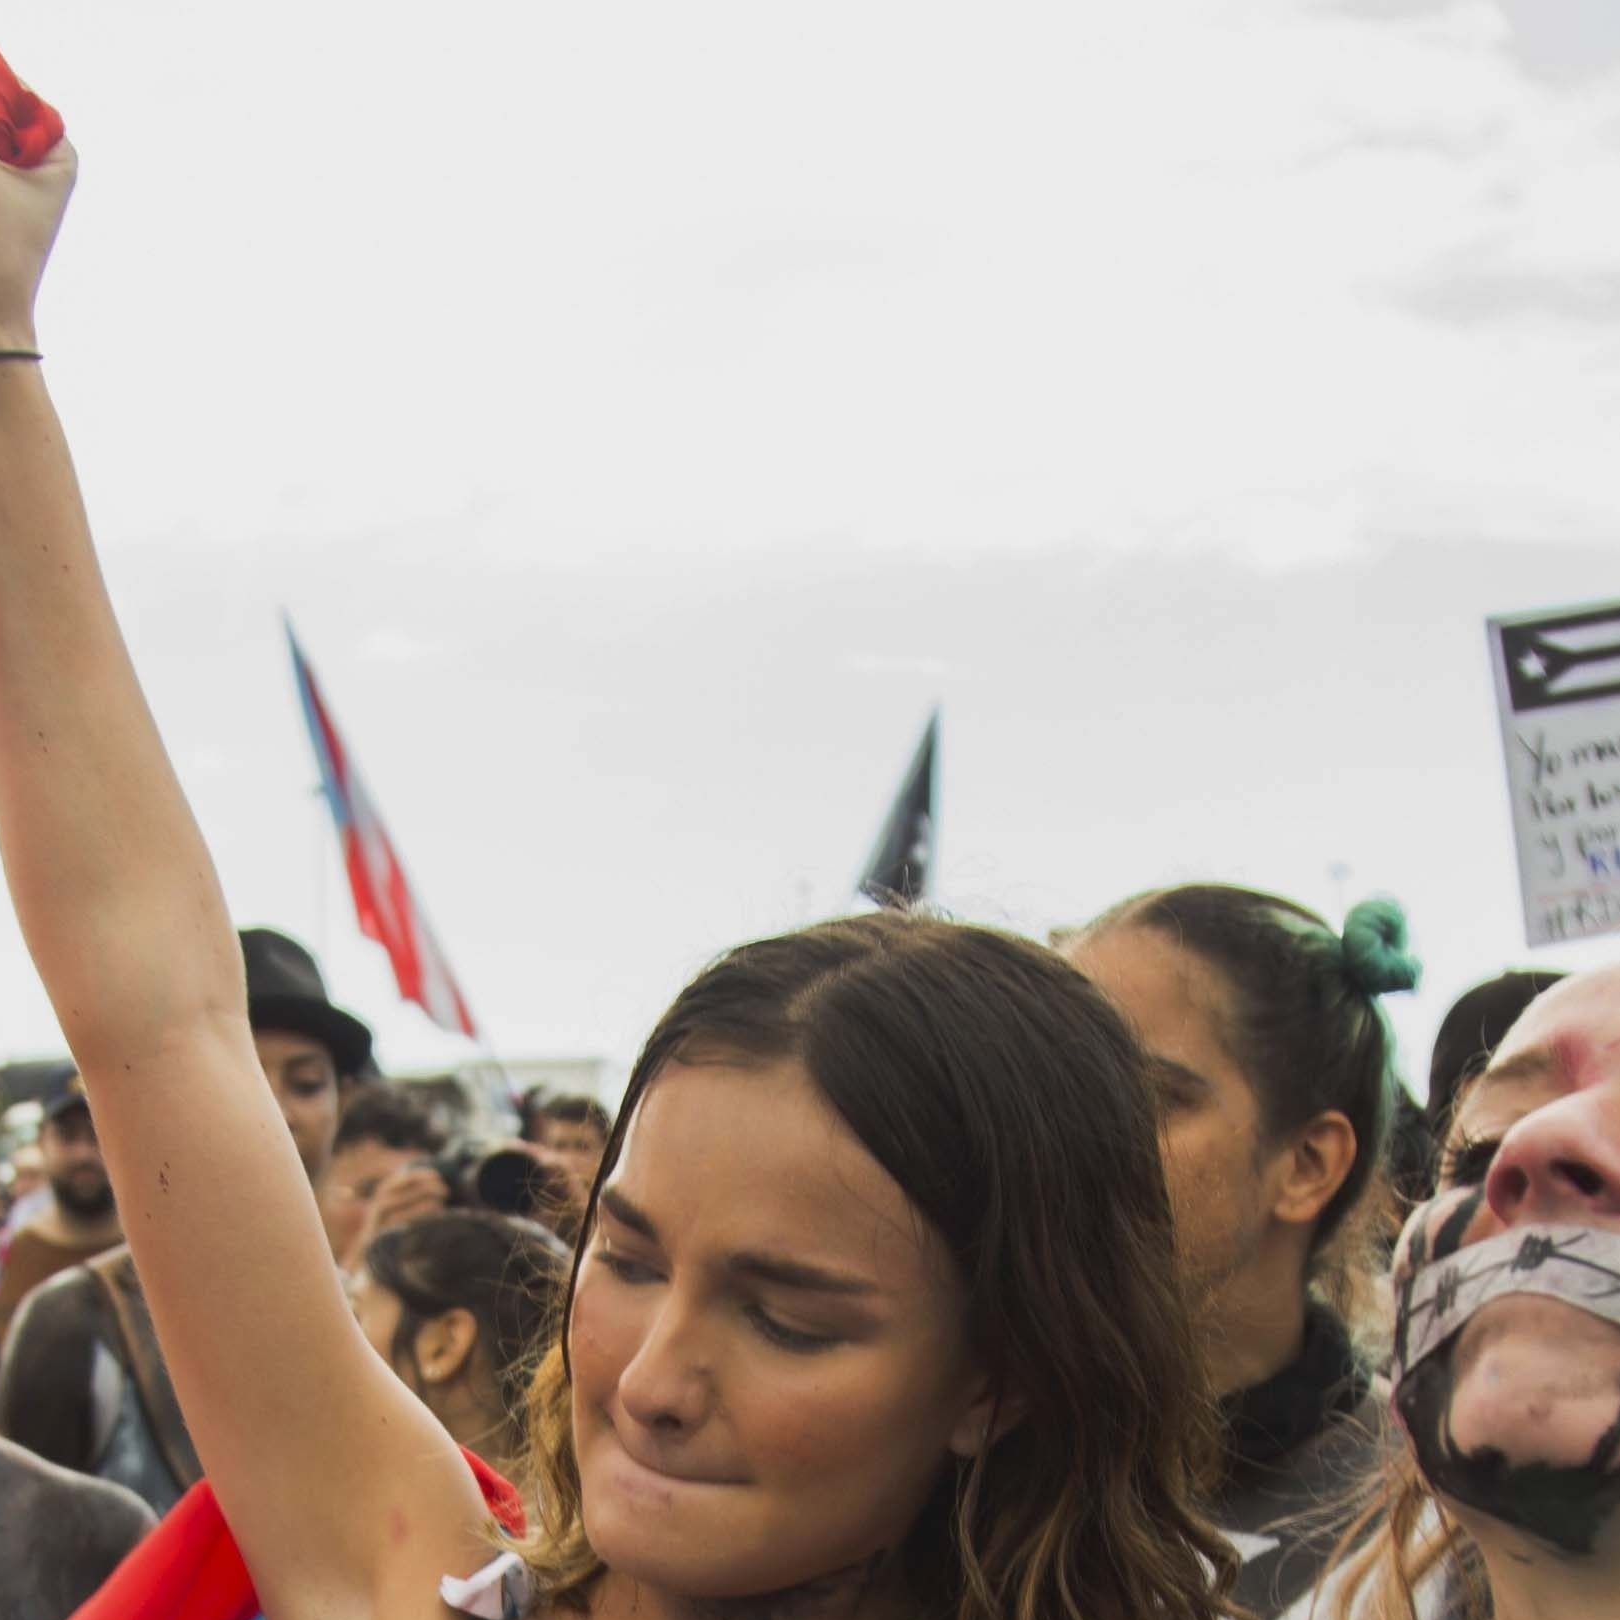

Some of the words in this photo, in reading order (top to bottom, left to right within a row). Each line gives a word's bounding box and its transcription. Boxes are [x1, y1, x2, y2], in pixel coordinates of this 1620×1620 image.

[1514, 726, 1562, 788] Yo
[1537, 832, 1565, 880] y
[1574, 822, 1618, 860] por
